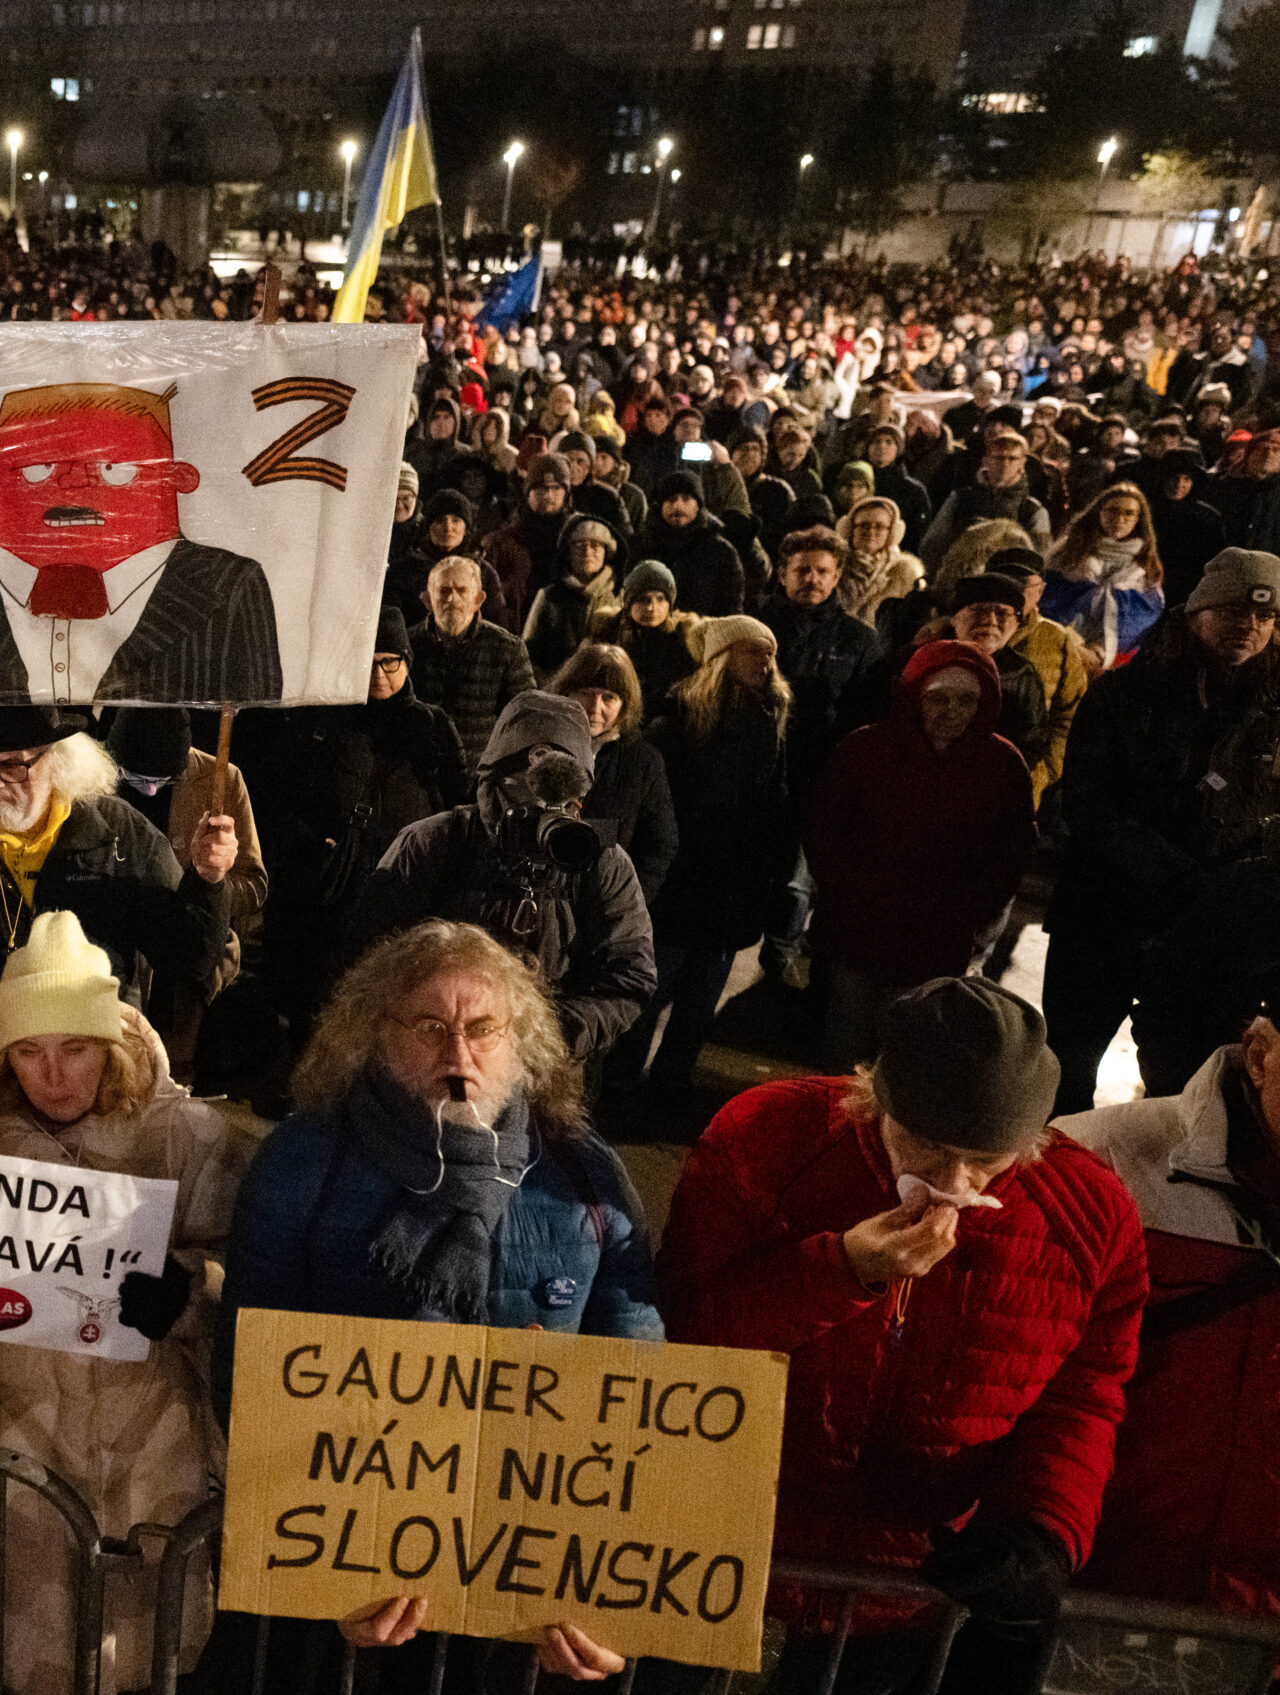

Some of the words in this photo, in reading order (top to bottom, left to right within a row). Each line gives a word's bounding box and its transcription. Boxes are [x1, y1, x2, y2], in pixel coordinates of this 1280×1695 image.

[281, 1344, 566, 1422] GAUNER
[597, 1372, 746, 1443] FICO
[308, 1419, 461, 1494] NÁM
[498, 1441, 652, 1513] NIČÍ
[266, 1504, 745, 1624] SLOVENSKO
